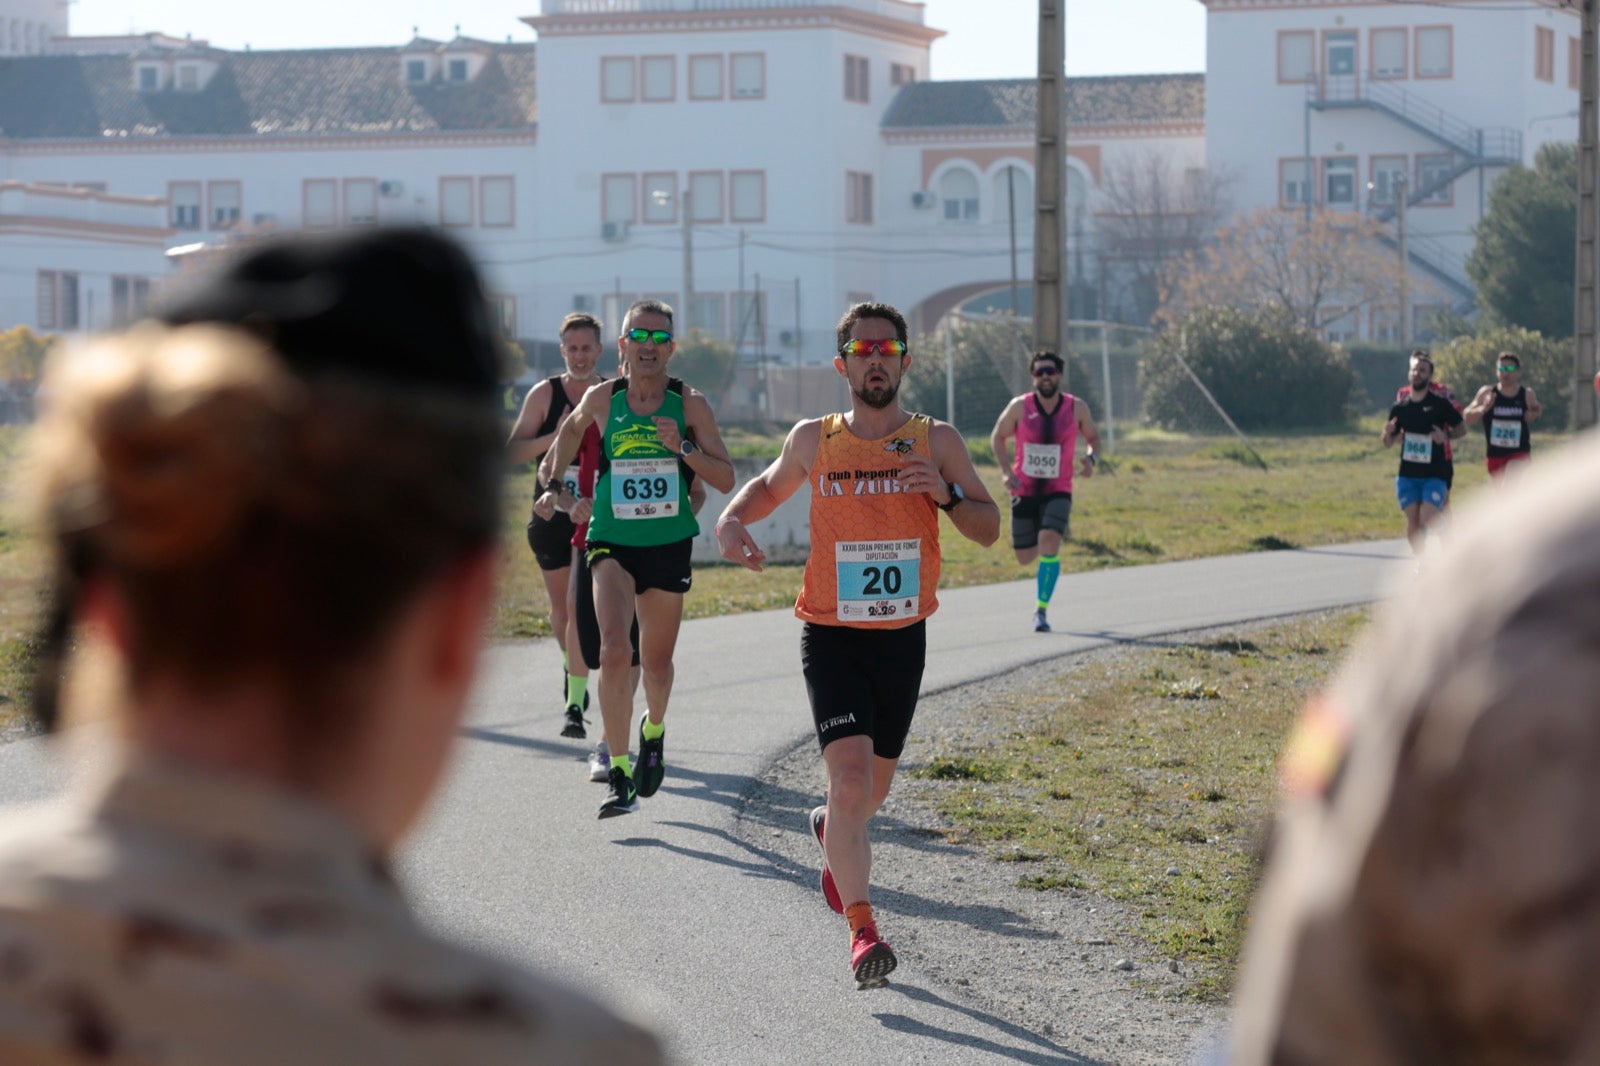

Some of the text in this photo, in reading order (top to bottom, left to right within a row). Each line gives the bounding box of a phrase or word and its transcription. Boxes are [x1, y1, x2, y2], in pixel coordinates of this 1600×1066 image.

[1495, 428, 1516, 440] 226
[1406, 442, 1426, 453] 968
[1027, 455, 1056, 467] 3050
[828, 471, 851, 480] Club
[623, 478, 668, 500] 639
[820, 475, 843, 497] LA
[858, 543, 873, 552] GRAN
[874, 542, 894, 551] PREMIO
[895, 542, 902, 550] DE
[866, 551, 898, 560] DIPUTACIÓN
[863, 566, 902, 595] 20
